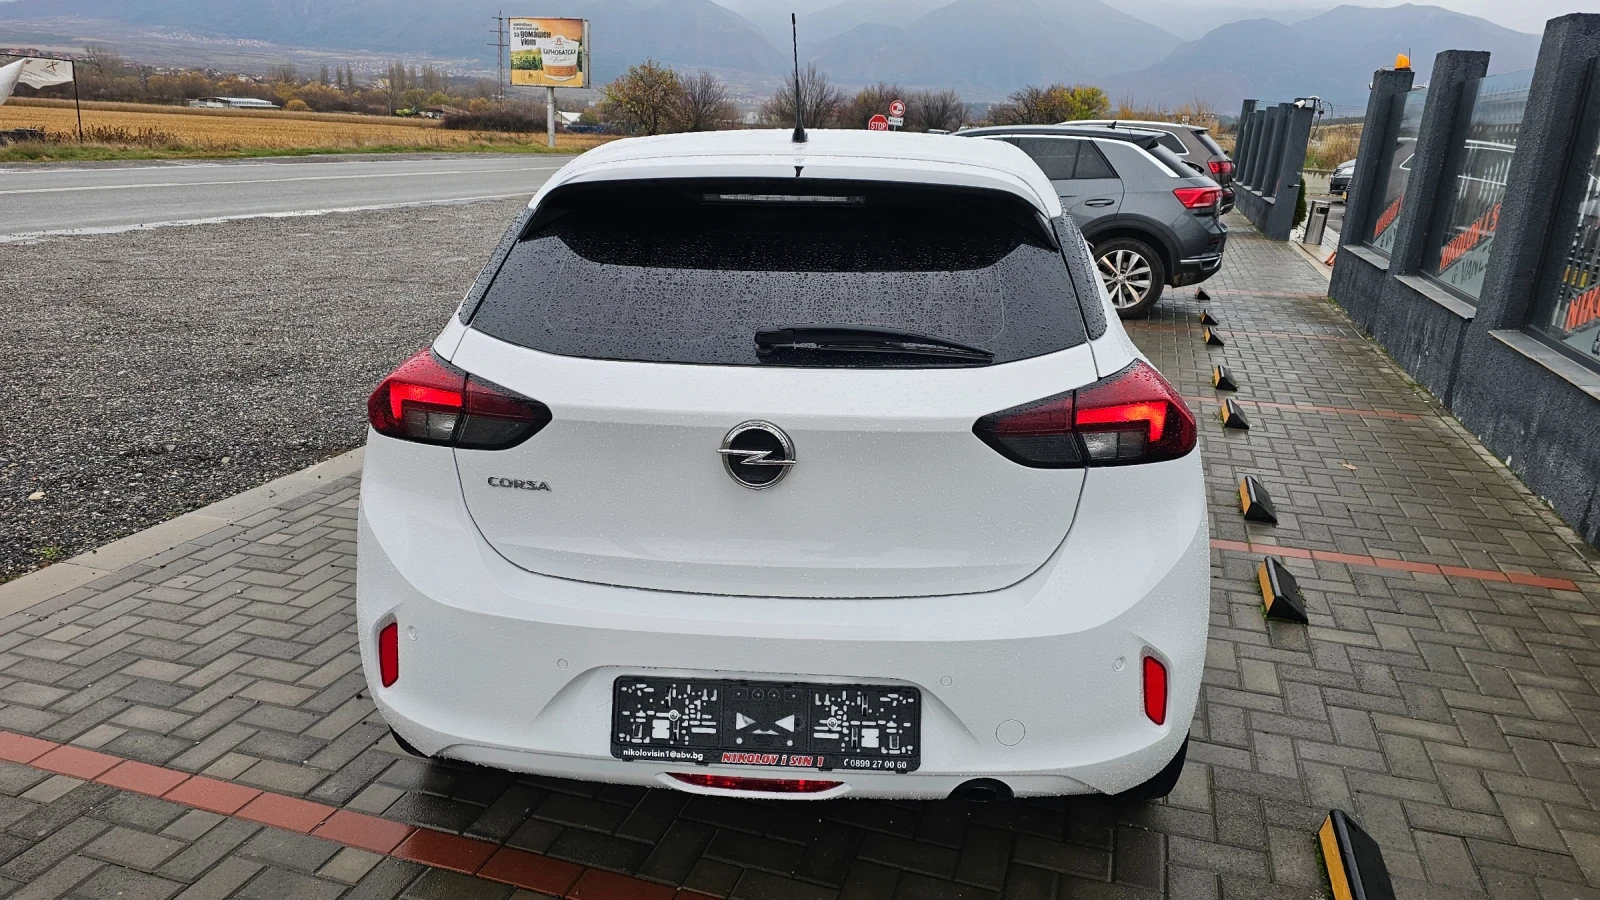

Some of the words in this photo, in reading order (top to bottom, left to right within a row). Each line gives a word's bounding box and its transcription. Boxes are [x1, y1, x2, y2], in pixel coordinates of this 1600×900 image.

[871, 121, 887, 130] STOP
[487, 476, 552, 492] CORSA
[623, 748, 704, 761] nikolovisin1@abv.bg
[722, 752, 779, 765] NIKOLOV
[789, 755, 813, 767] SIN
[850, 759, 870, 767] 0899
[872, 760, 883, 768] 27
[884, 760, 895, 768] 00
[896, 761, 907, 769] 60
